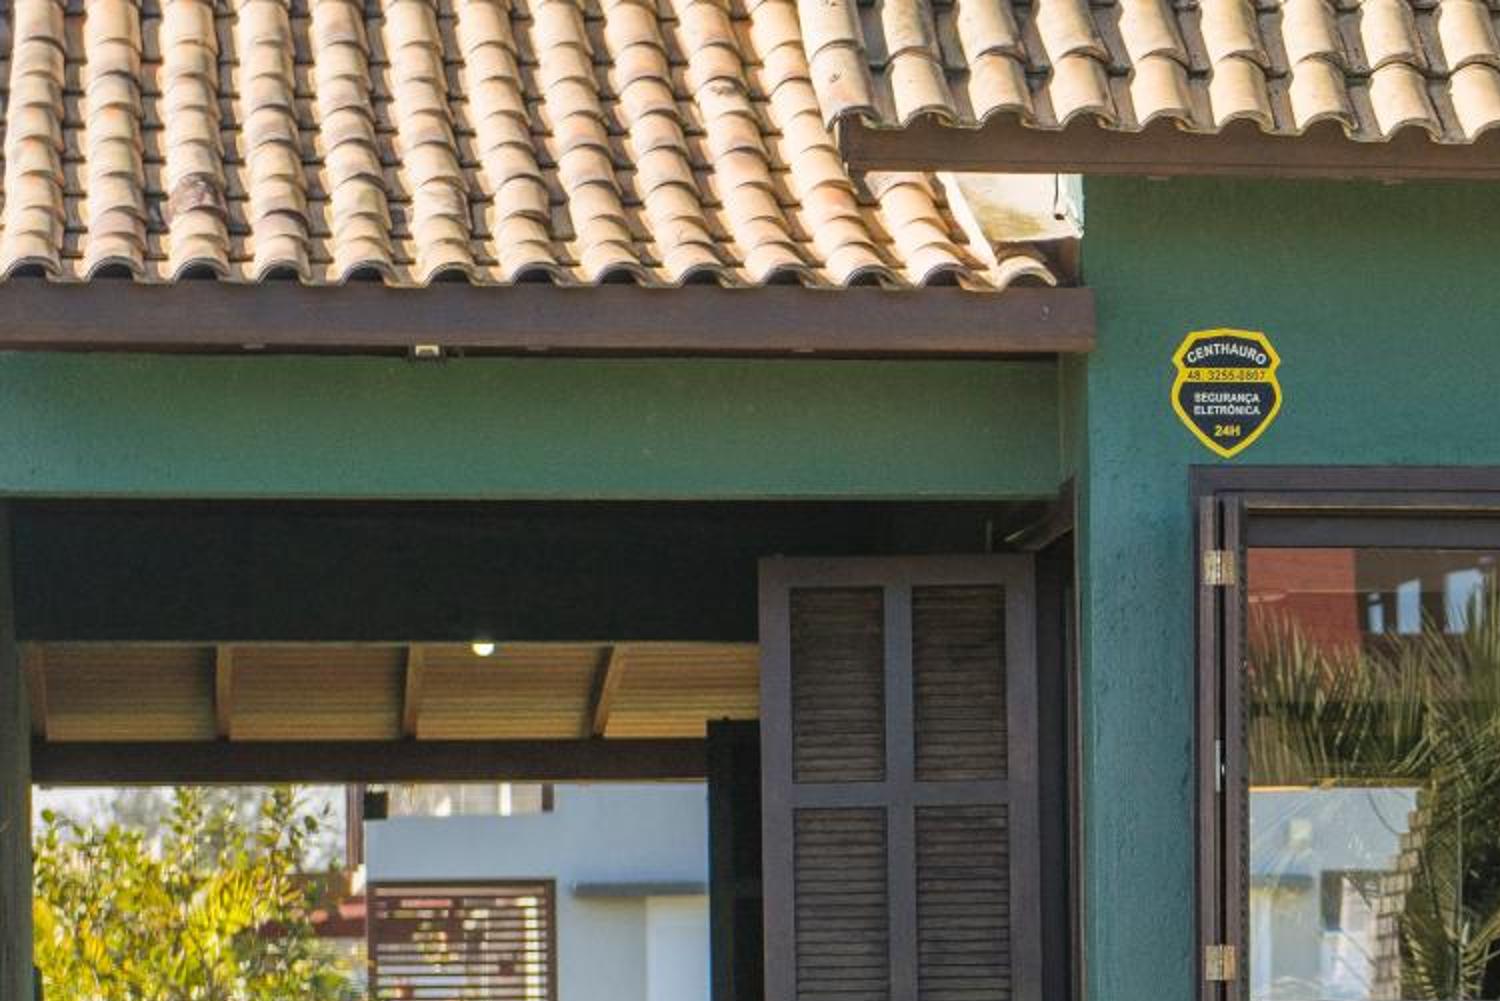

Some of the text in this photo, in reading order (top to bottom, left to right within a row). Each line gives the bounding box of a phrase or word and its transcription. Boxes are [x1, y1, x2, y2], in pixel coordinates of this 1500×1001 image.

[1187, 343, 1267, 365] CENTHAURO
[1194, 392, 1260, 404] SEGURANÇA
[1194, 404, 1261, 415] ELETRÔNICA
[1215, 425, 1241, 437] 24H
